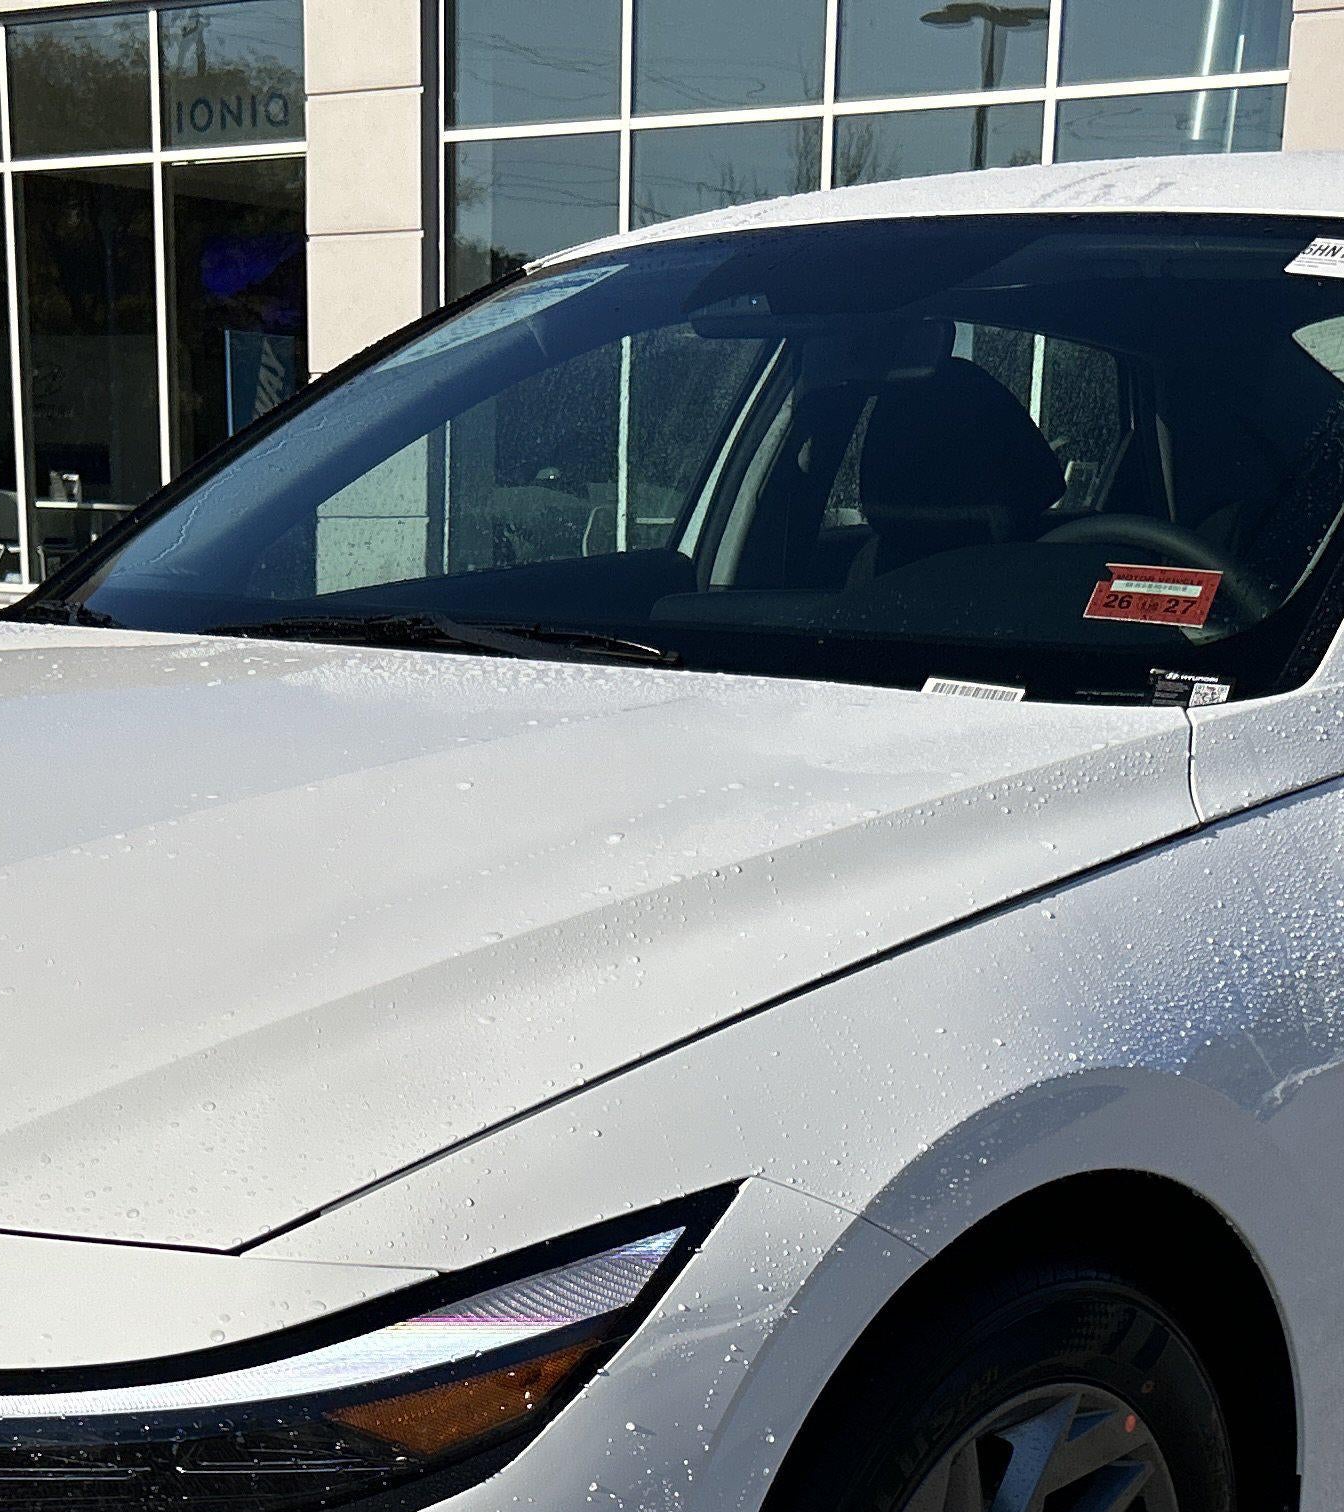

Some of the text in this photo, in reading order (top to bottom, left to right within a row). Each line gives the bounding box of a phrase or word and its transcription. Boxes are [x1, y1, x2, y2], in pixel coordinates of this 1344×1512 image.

[177, 92, 289, 133] IONIQ
[1103, 594, 1133, 609] 26
[1163, 599, 1197, 614] 27
